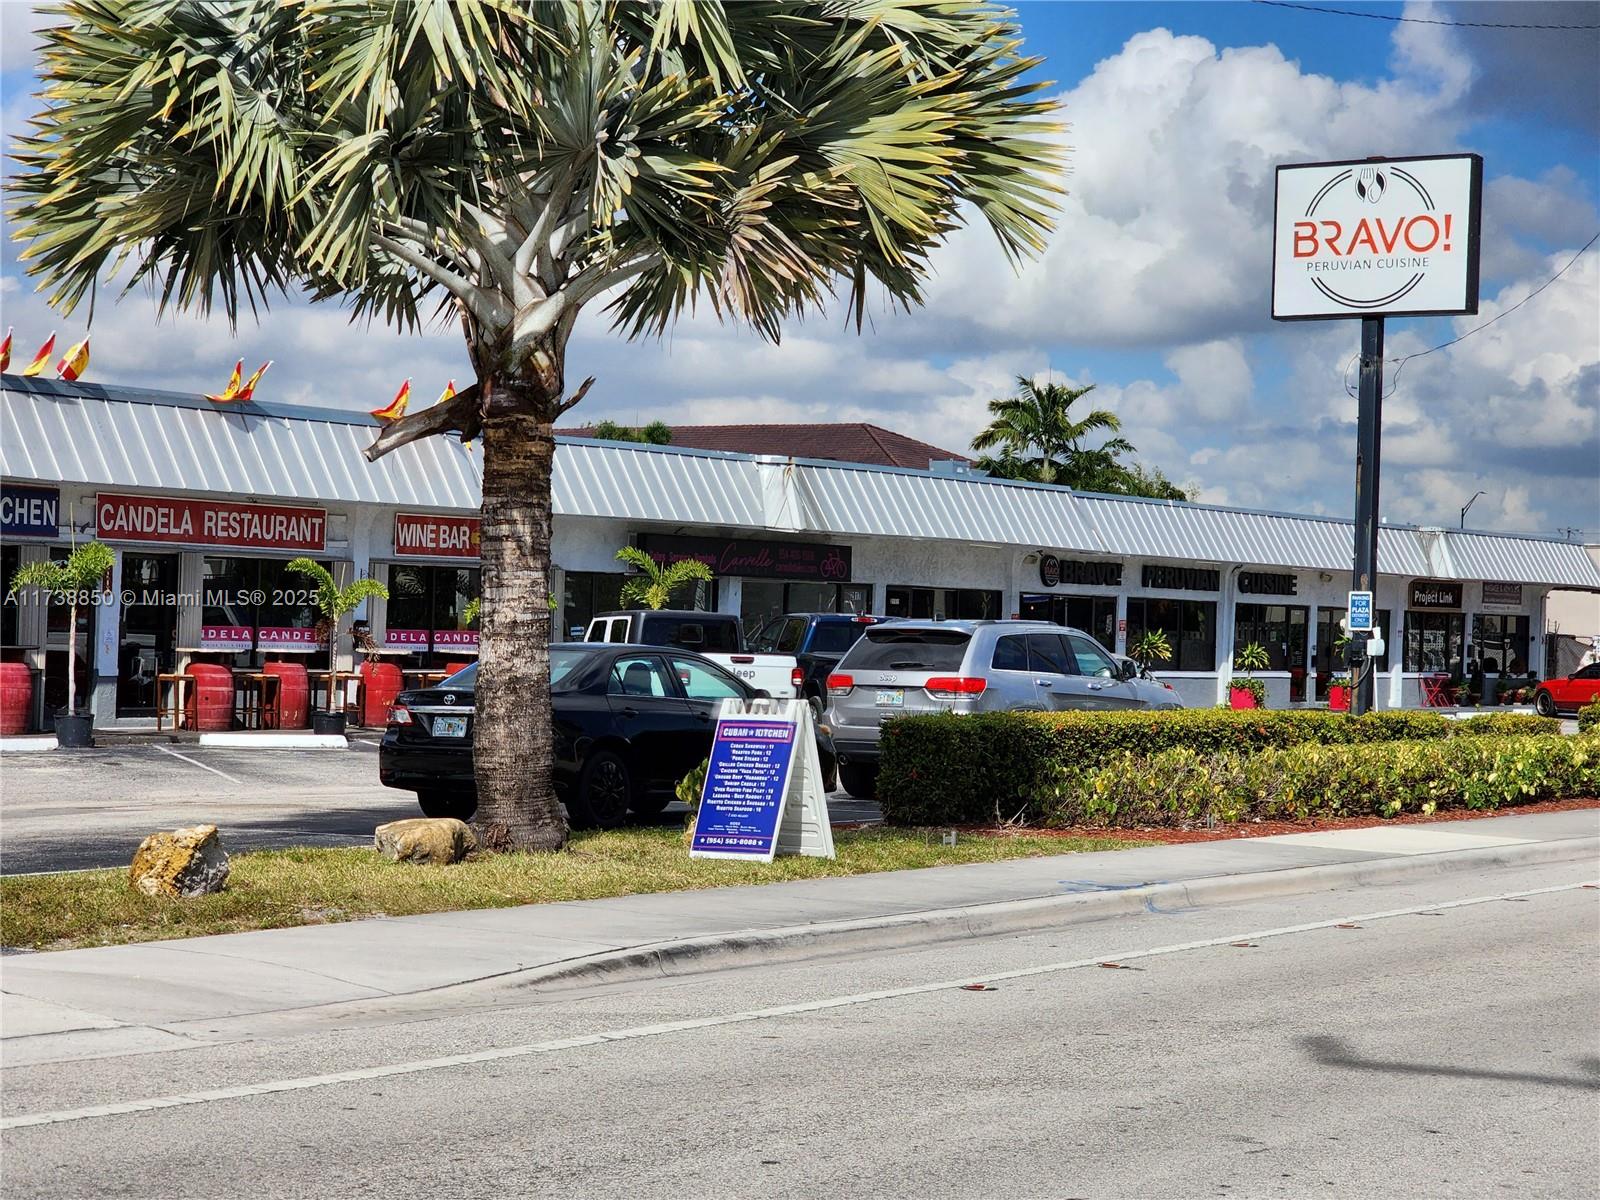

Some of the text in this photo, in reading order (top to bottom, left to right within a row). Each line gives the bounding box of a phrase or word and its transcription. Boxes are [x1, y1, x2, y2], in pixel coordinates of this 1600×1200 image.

[1293, 213, 1452, 258] BRAVO!
[1306, 257, 1430, 272] PERUVIAN CUISINE
[100, 503, 324, 543] CANDELA RESTAURANT
[397, 522, 470, 549] WINE BAR
[1141, 564, 1221, 592] PERUVIAN
[1238, 571, 1298, 595] CUISINE
[1414, 590, 1453, 605] Project Link
[879, 672, 897, 683] Jeep
[723, 728, 789, 738] CUBAN KITCHEN
[706, 837, 724, 845] (954)
